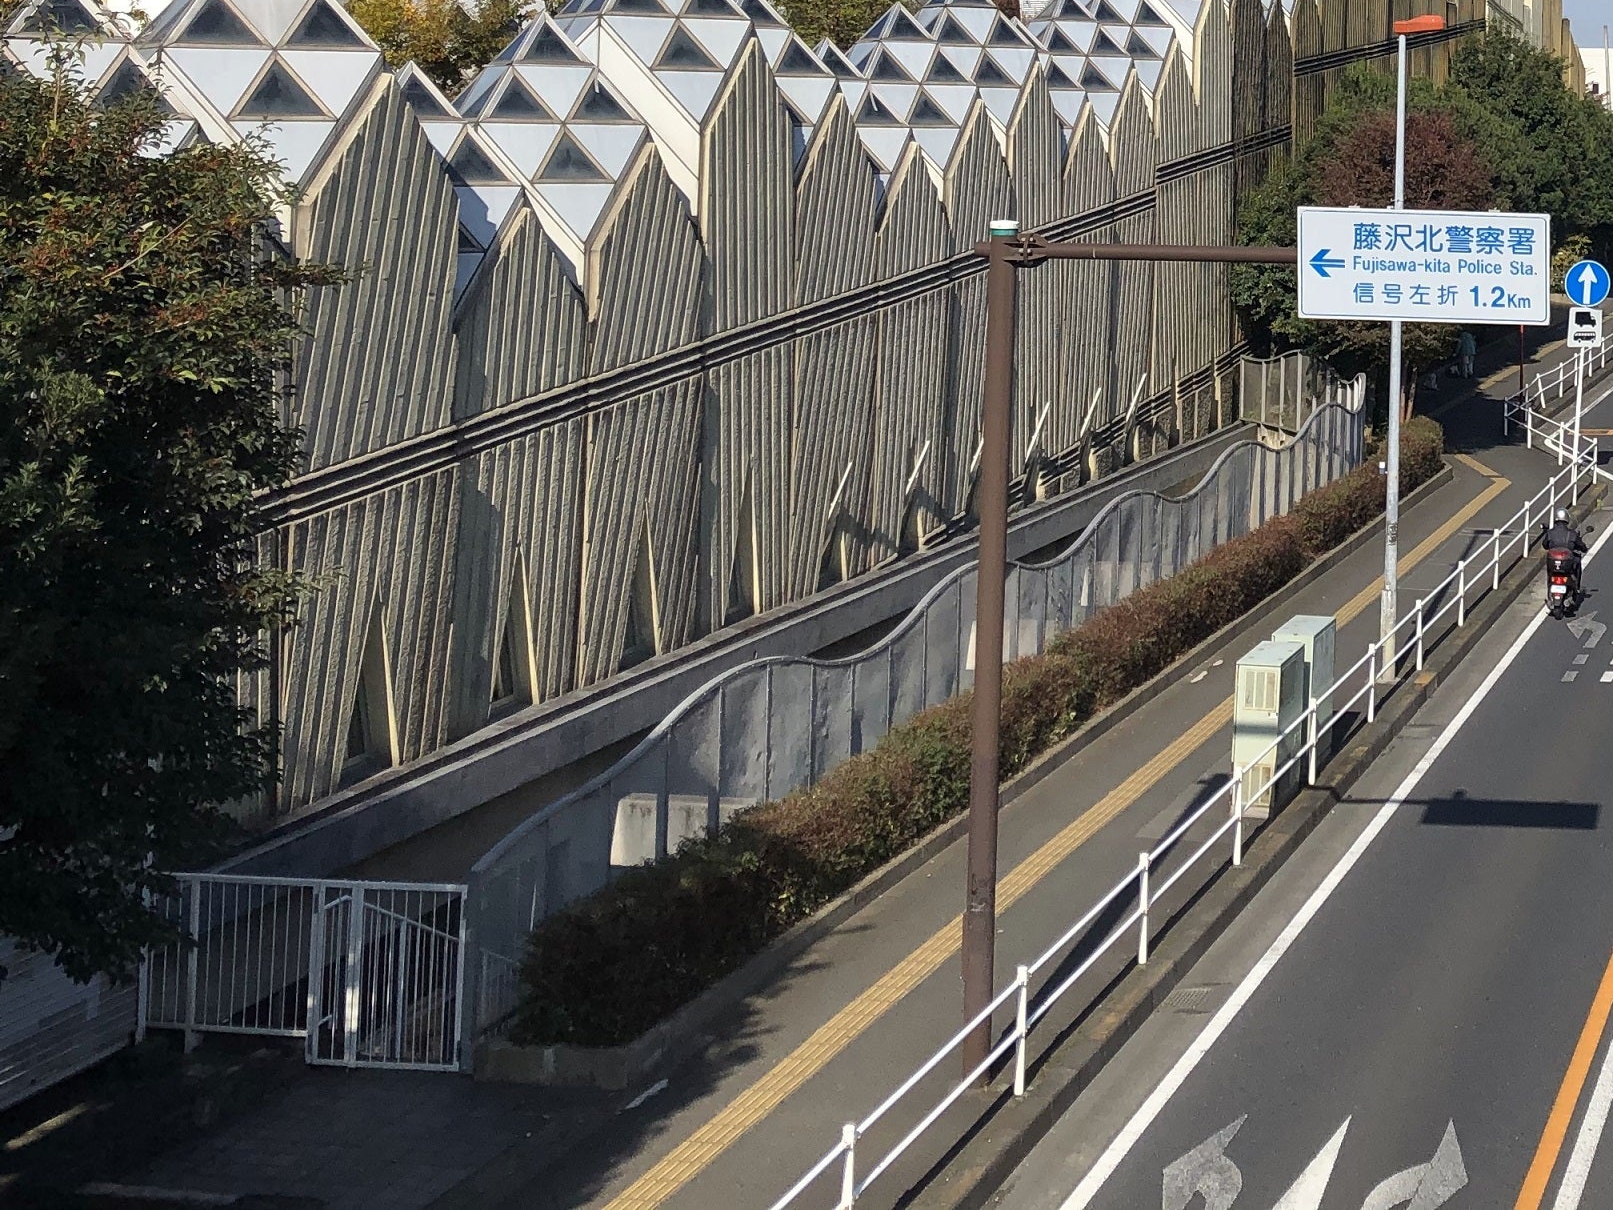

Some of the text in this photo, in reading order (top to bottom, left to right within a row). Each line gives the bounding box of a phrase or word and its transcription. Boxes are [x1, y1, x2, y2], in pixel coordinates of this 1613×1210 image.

[1353, 222, 1536, 255] 藤沢北警察署
[1353, 255, 1538, 276] Fujisawa-kita Police Sta.
[1353, 282, 1531, 309] 信号左折 1.2Km
